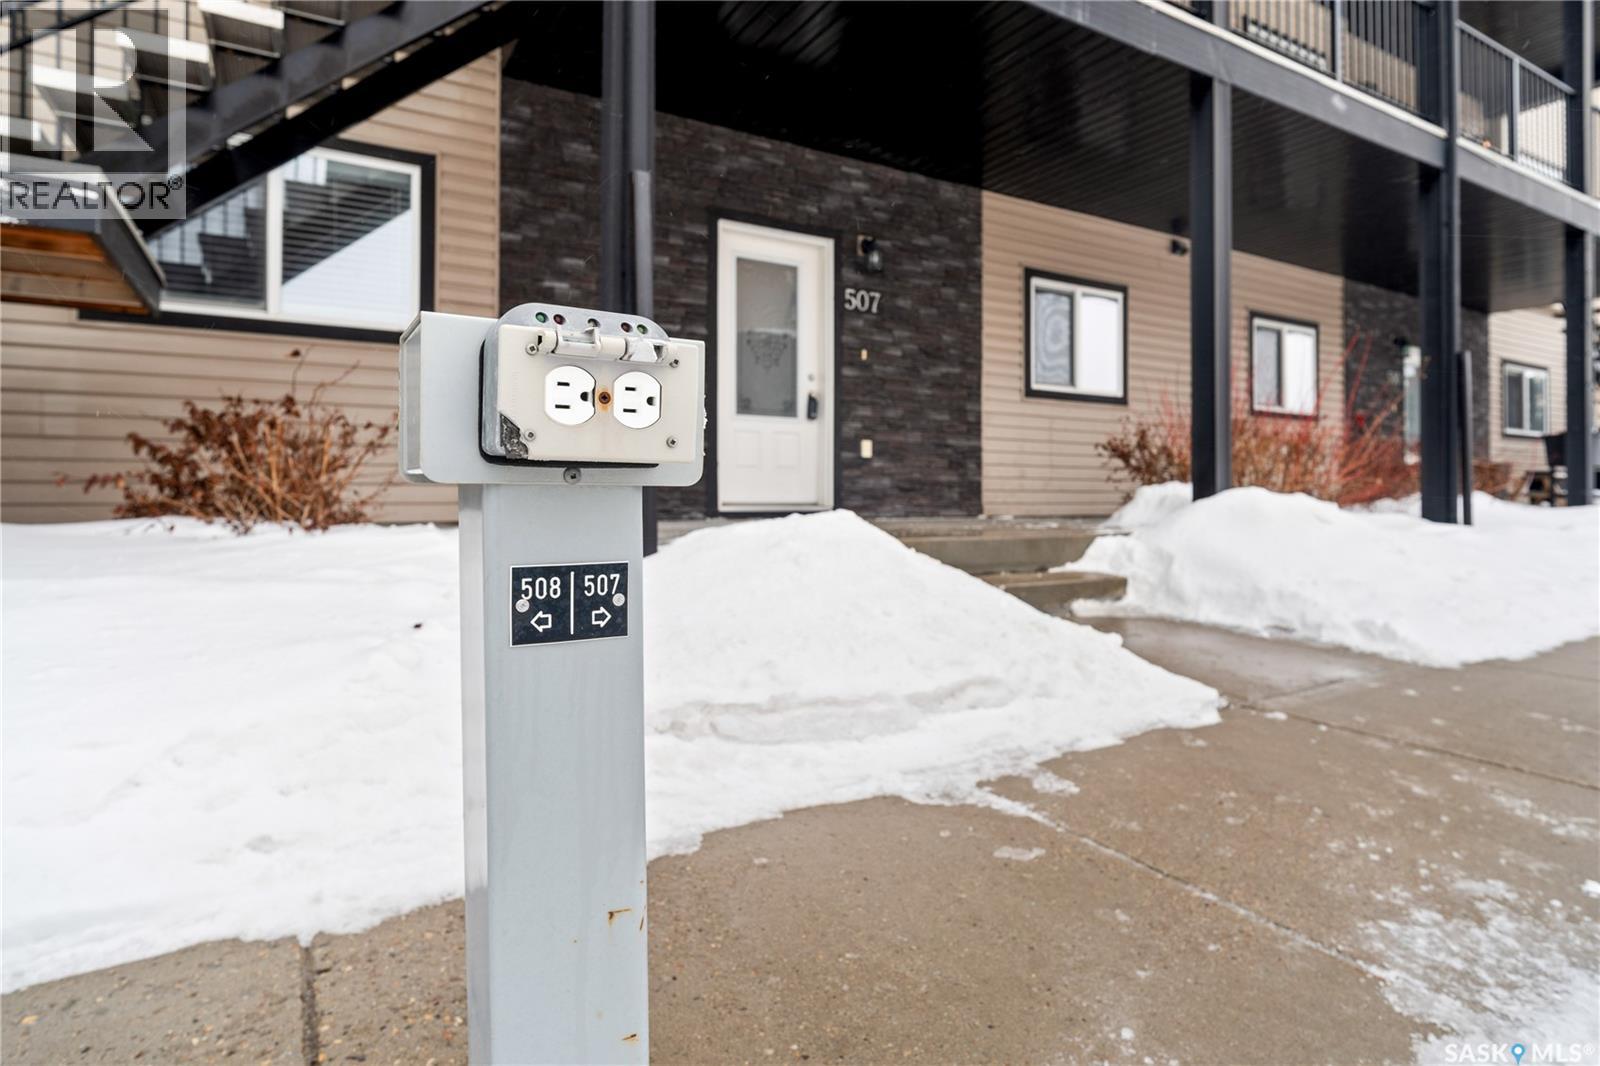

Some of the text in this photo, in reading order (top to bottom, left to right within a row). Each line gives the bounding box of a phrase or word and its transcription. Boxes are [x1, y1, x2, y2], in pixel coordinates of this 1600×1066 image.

[844, 287, 881, 313] 507
[521, 574, 620, 599] 508 507
